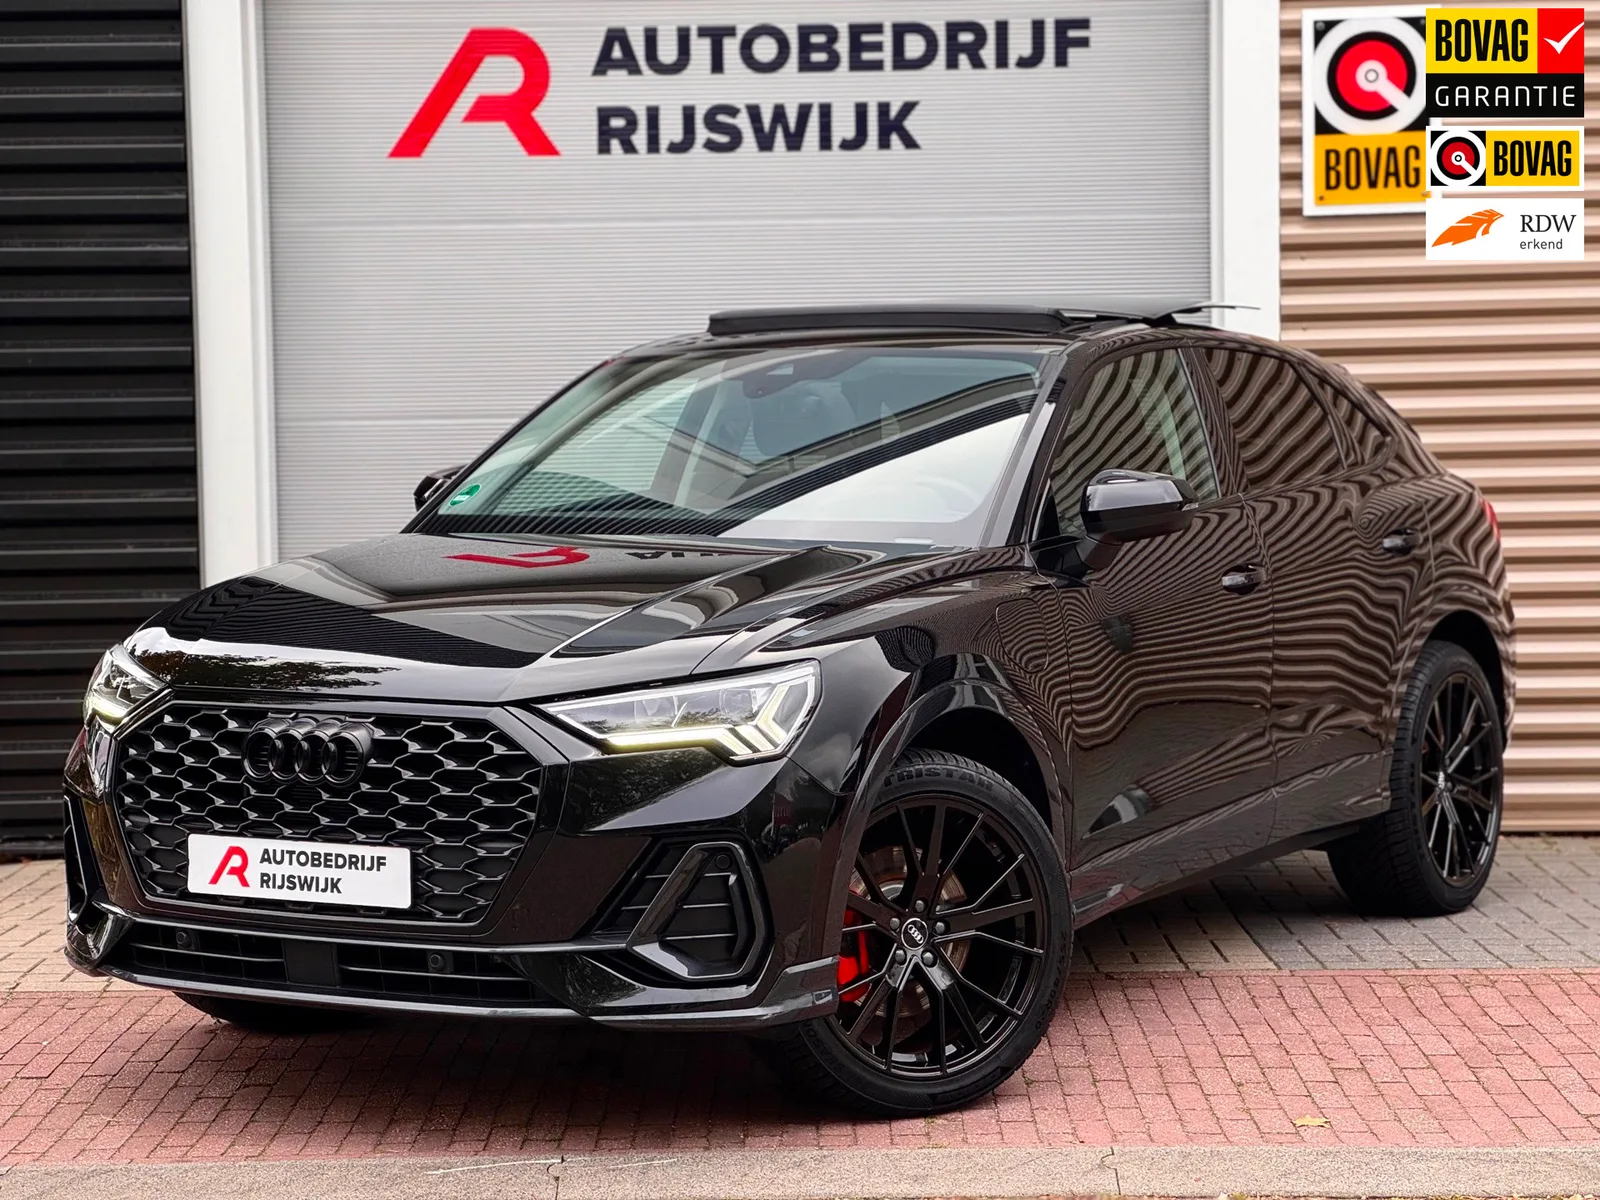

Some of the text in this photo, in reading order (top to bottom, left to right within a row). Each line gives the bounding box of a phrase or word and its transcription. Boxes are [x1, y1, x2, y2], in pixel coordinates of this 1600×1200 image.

[592, 18, 1091, 76] AUTOBEDRIJF
[597, 101, 921, 155] RIJSWIJK
[1325, 145, 1421, 191] BOVAG
[259, 848, 387, 872] AUTOBEDRIJF
[260, 872, 342, 894] RIJSWIJK
